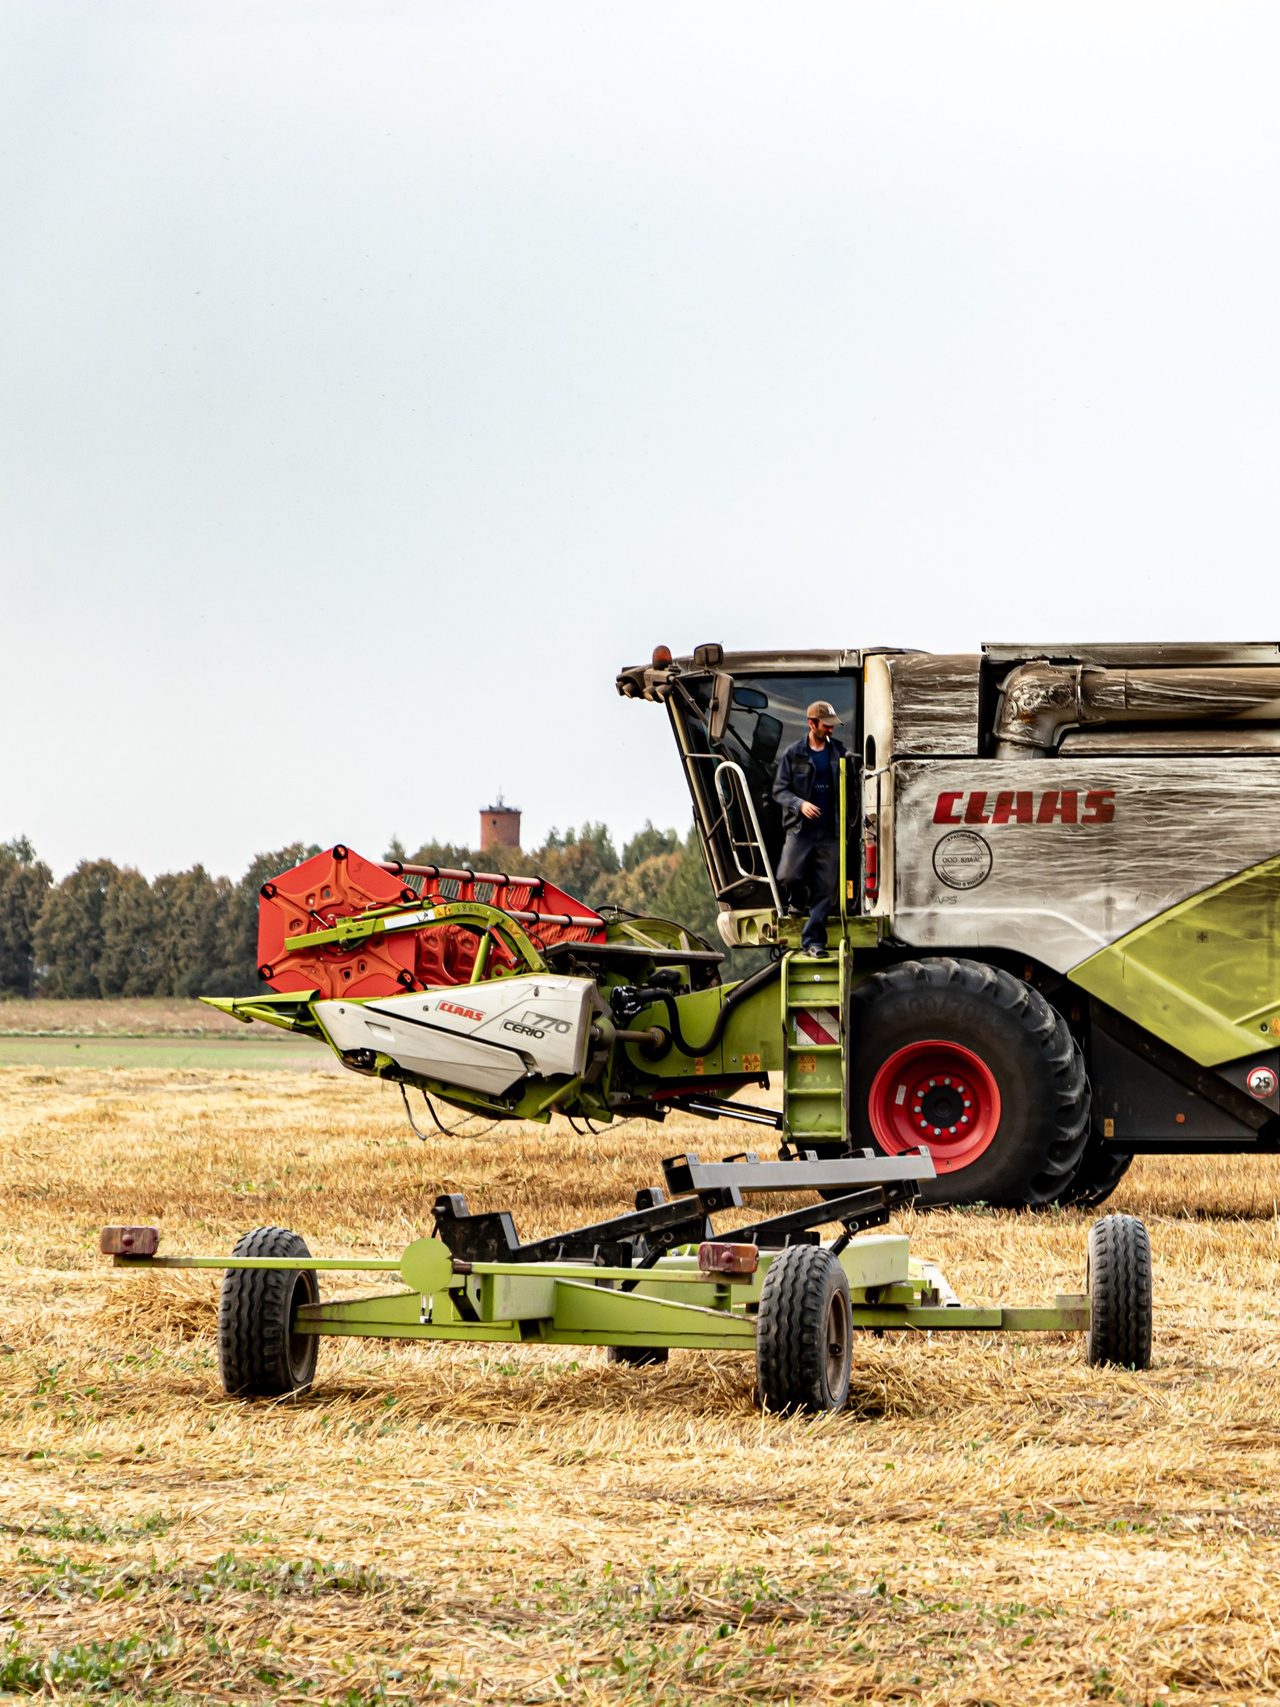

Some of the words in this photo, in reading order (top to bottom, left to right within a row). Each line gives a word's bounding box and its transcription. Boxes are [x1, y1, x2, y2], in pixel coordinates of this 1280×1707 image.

[933, 790, 1116, 824] CLAAS
[439, 1001, 484, 1022] CLAAS
[503, 1021, 545, 1039] CERIO
[532, 1013, 571, 1034] 770
[1255, 1077, 1270, 1089] 25
